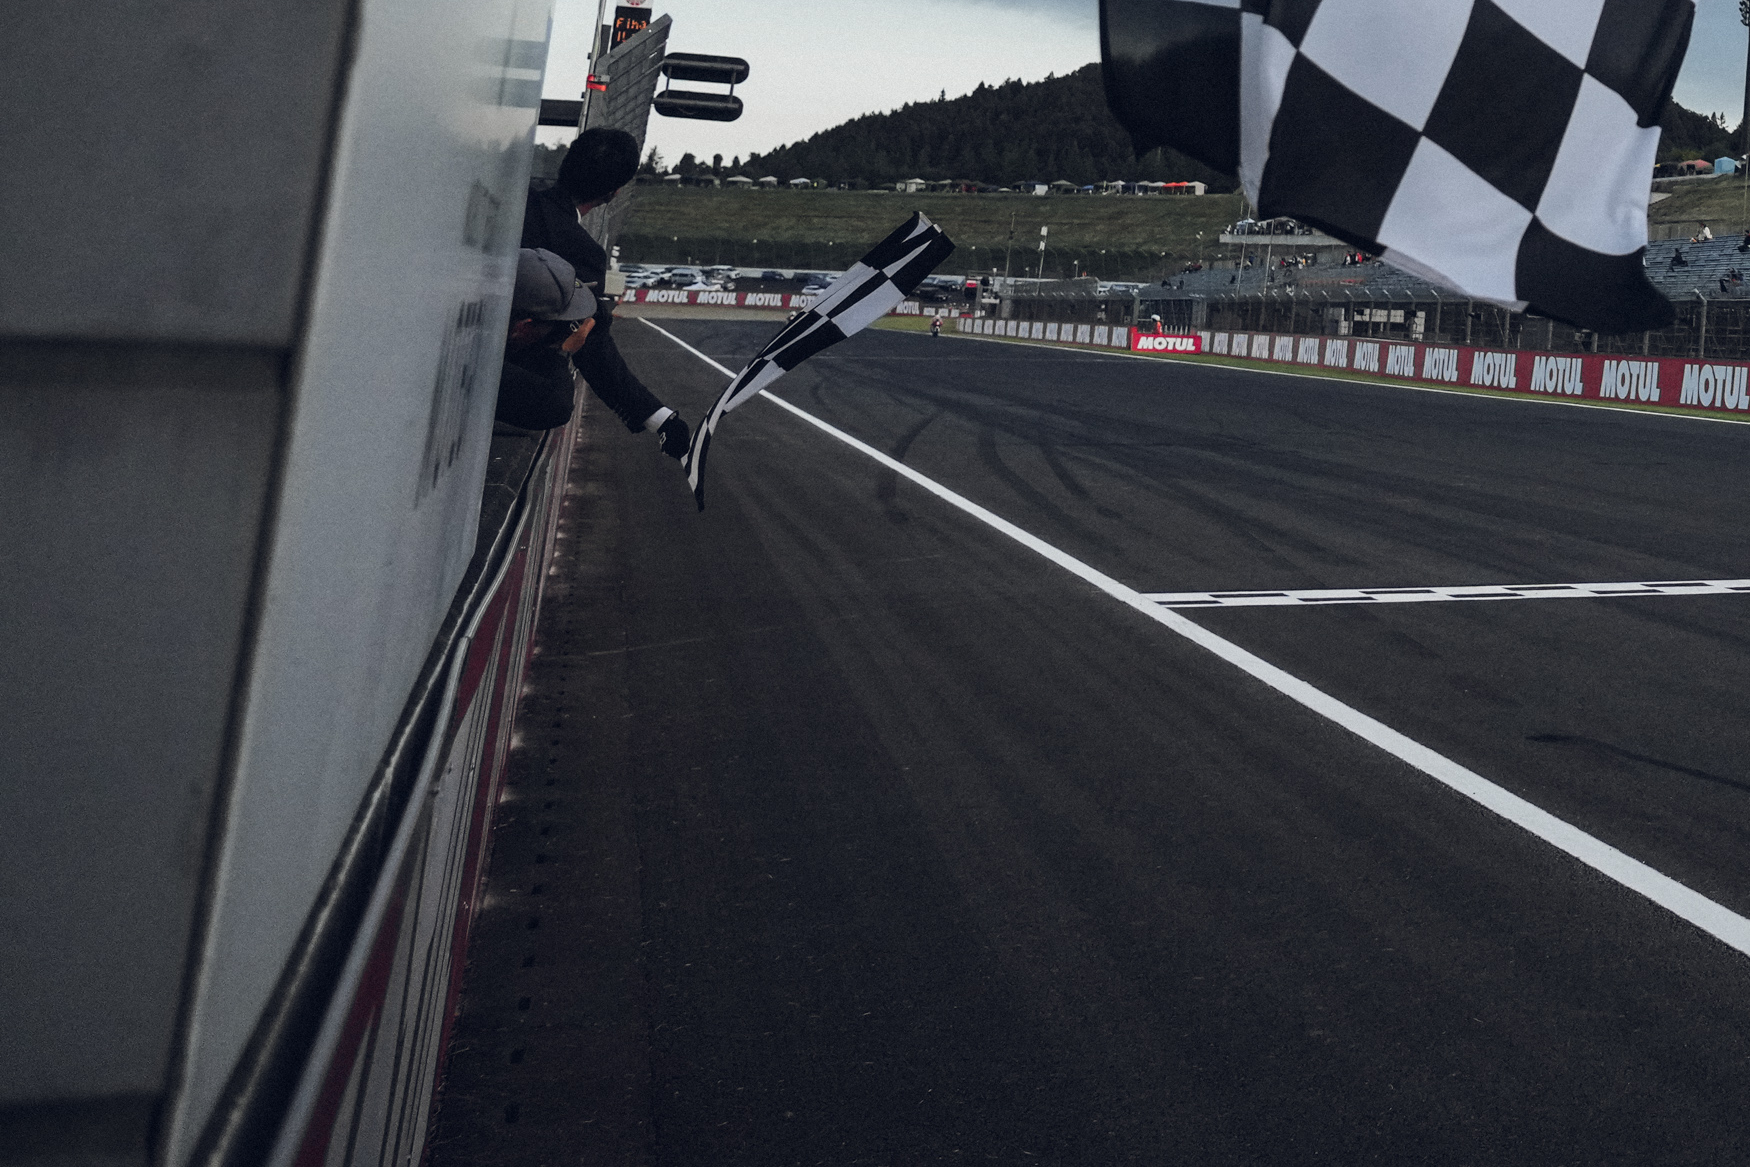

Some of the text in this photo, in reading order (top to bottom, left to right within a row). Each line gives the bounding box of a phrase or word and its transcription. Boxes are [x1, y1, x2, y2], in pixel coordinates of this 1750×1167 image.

[645, 290, 688, 303] MOTUL
[697, 291, 737, 305] MOTUL
[744, 293, 782, 306] MOTUL
[1137, 336, 1196, 351] MOTUL
[1353, 341, 1380, 372] MOTUL
[1386, 345, 1415, 376] MOTUL
[1422, 347, 1459, 382] MOTUL
[1470, 351, 1517, 389] MOTUL
[1530, 355, 1583, 395] MOTUL
[1600, 360, 1661, 402] MOTUL
[1679, 364, 1750, 410] MOTUL
